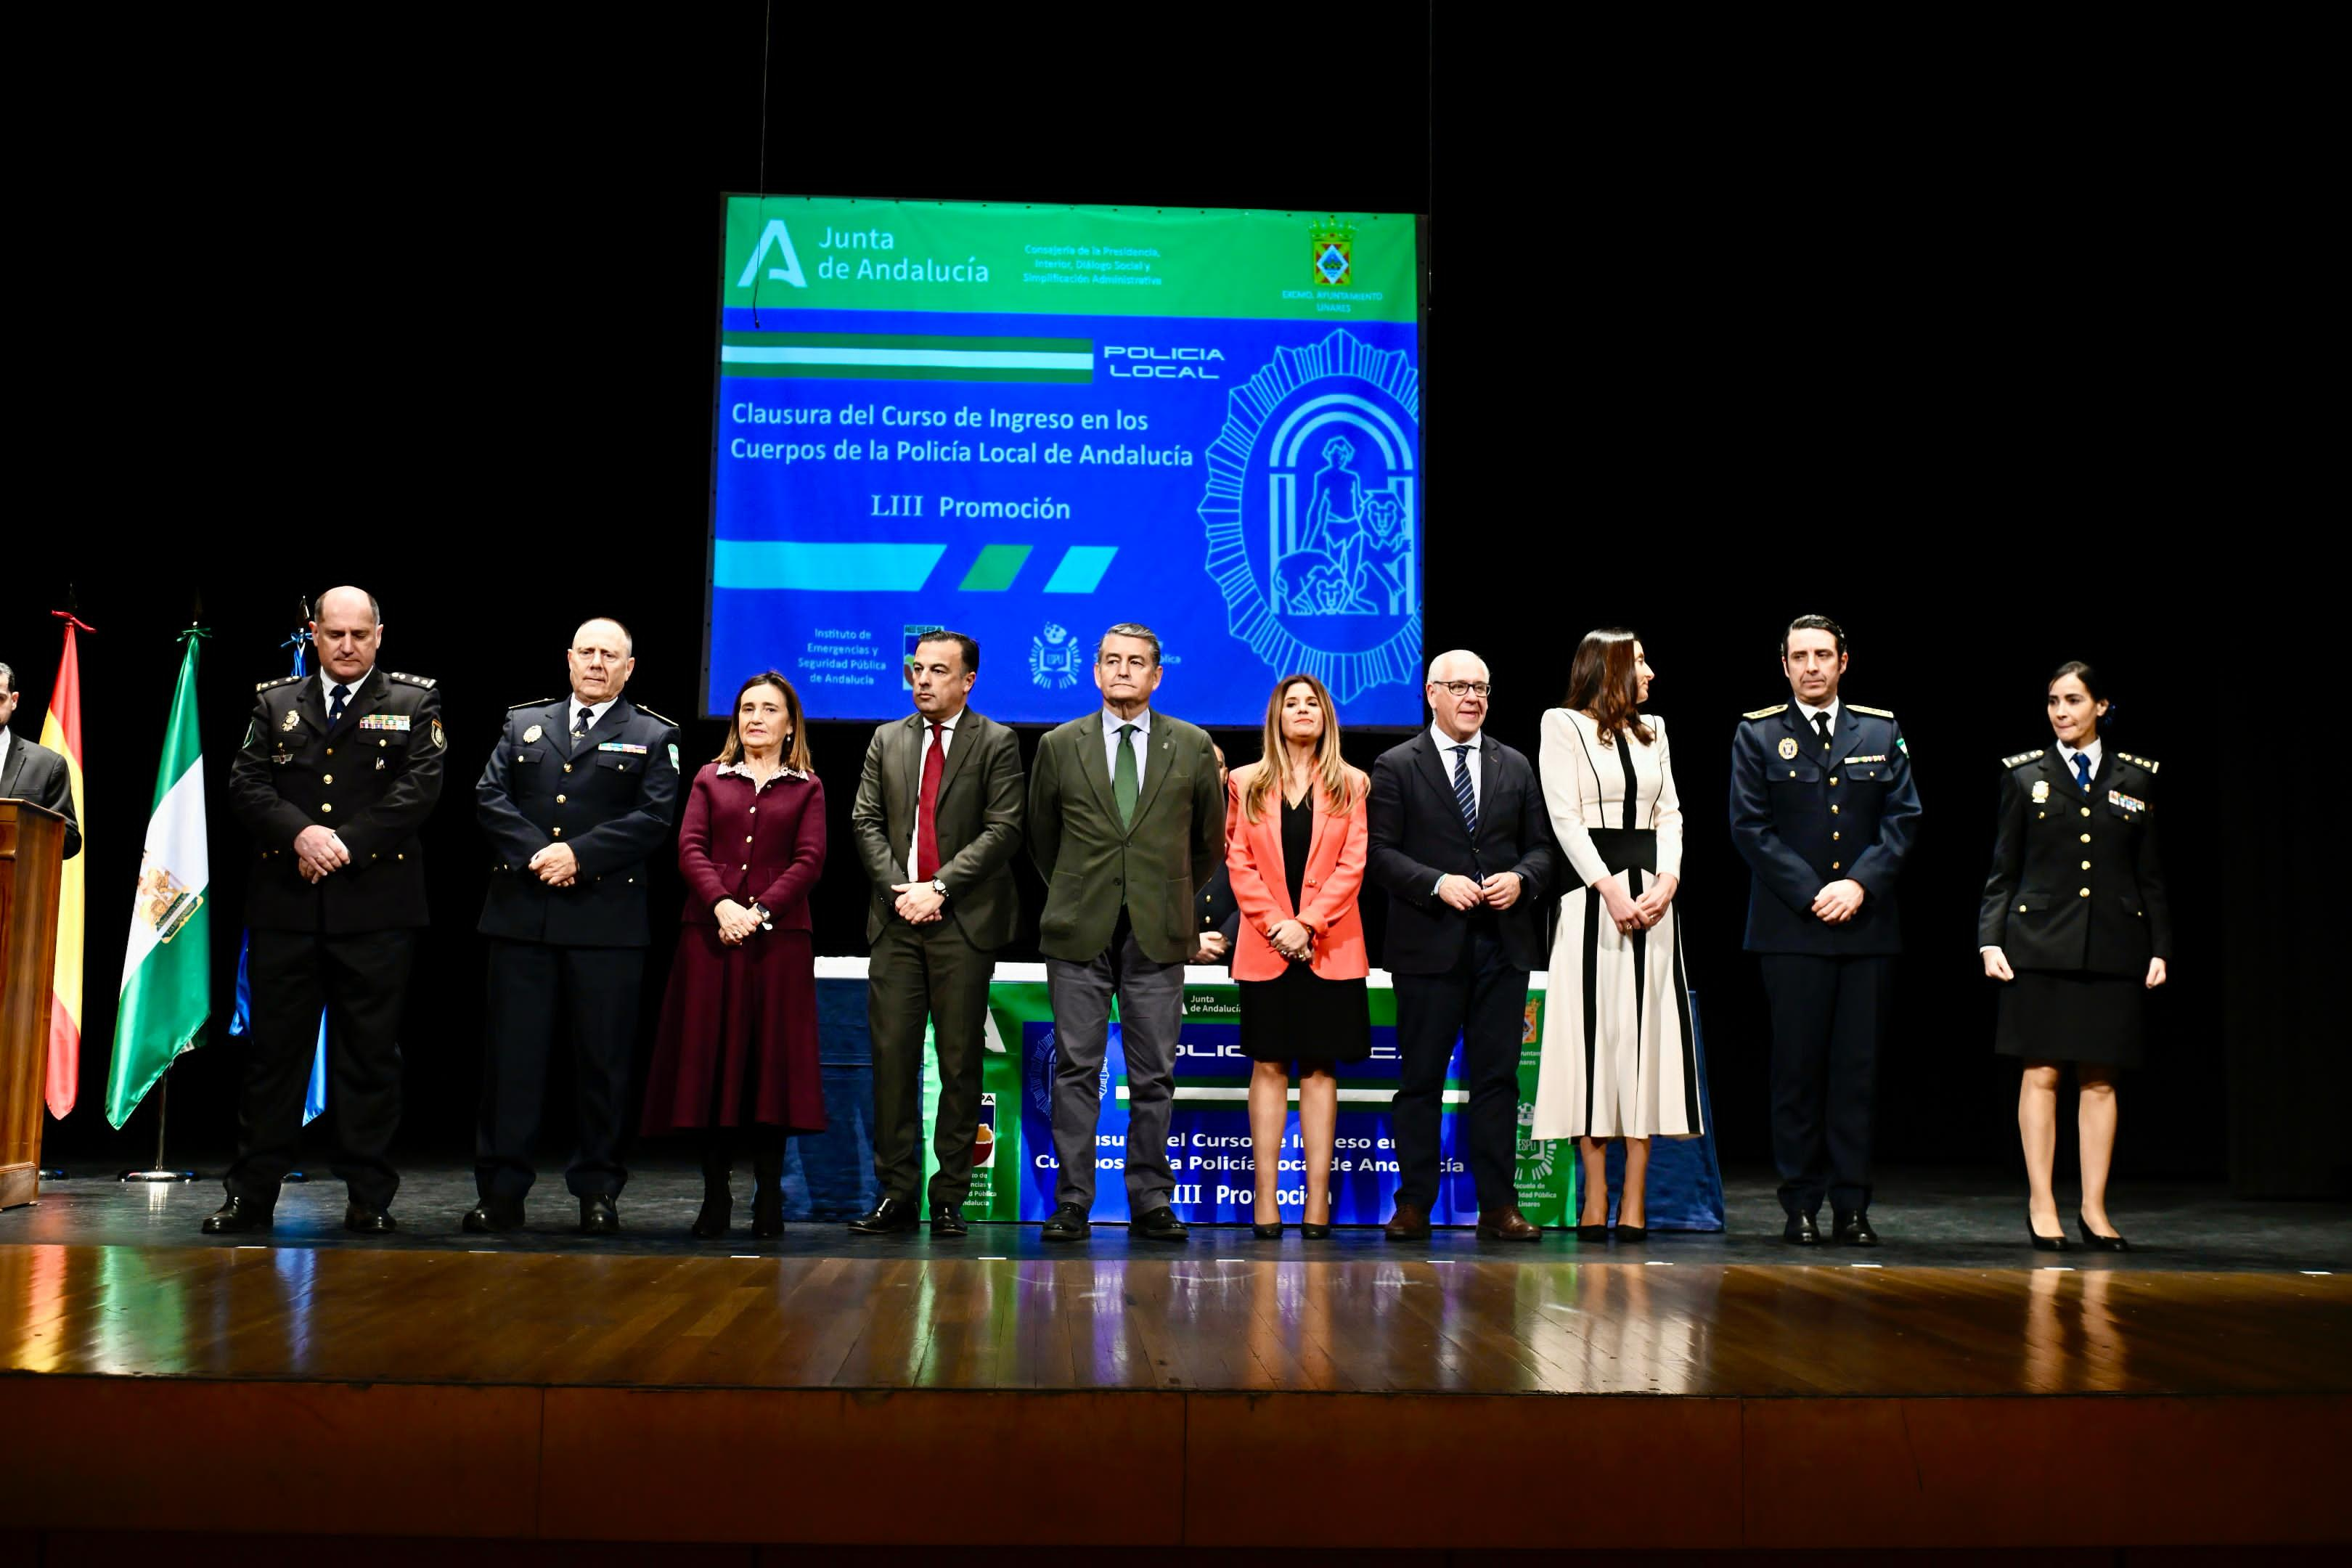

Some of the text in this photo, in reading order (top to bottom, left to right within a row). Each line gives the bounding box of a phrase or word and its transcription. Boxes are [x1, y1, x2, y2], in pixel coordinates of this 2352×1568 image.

[818, 226, 895, 250] Junta
[1077, 245, 1089, 256] de
[1092, 245, 1101, 256] la
[818, 256, 989, 282] de Andalucía
[1115, 261, 1143, 271] Social
[1145, 263, 1151, 272] y
[1103, 346, 1225, 361] POLICIA
[1110, 365, 1219, 379] LOCAL
[732, 402, 1148, 433] Clausura del Curso de Ingreso en los
[730, 438, 1193, 467] Cuerpos de la Policía Local de Andalucía
[870, 494, 1070, 519] LIII Promoción
[814, 629, 871, 640] Instituto de
[808, 643, 878, 656] Emergencias y
[798, 658, 886, 670] Seguridad Pública
[810, 674, 874, 685] de Andalucía
[1167, 1132, 1185, 1147] el
[1192, 1133, 1253, 1148] Curso
[1189, 1156, 1255, 1171] Policía
[1170, 1184, 1202, 1204] III
